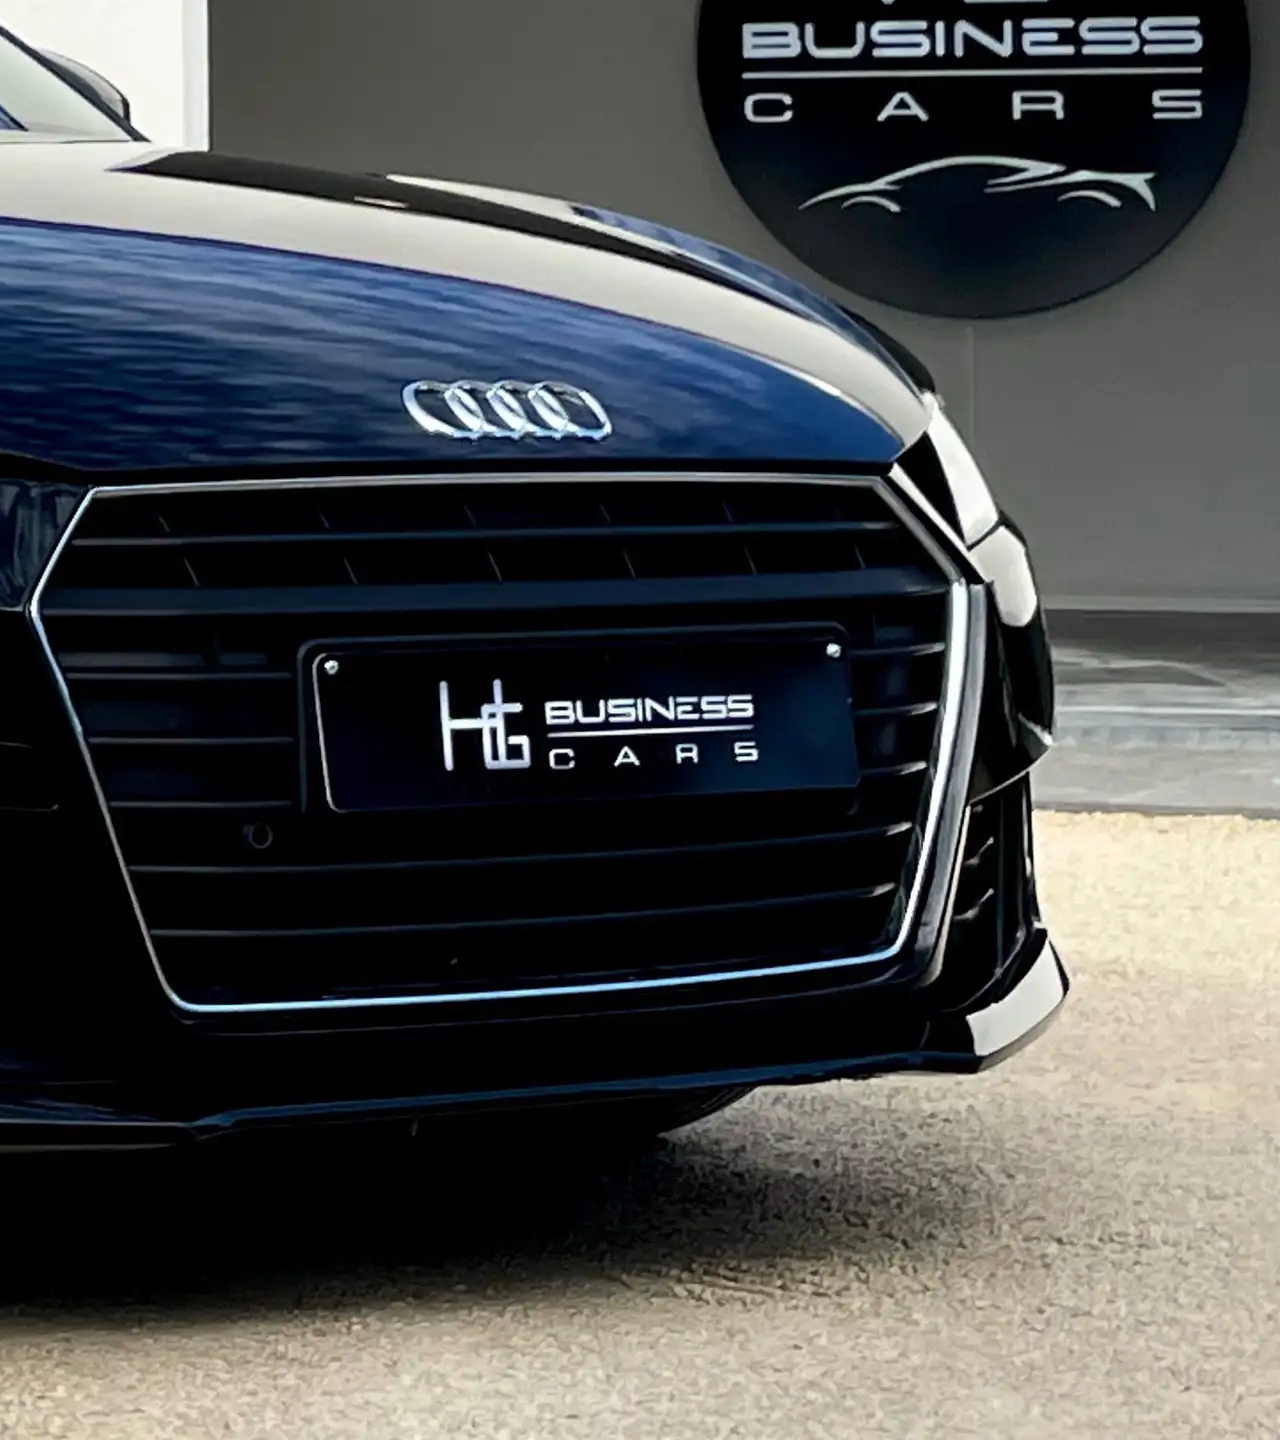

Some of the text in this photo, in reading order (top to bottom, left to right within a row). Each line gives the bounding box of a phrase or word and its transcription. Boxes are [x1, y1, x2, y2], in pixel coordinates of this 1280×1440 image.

[741, 16, 1203, 59] BUSINESS
[743, 89, 1203, 123] CARS
[543, 694, 756, 726] BUSINESS
[547, 741, 760, 771] CARS
